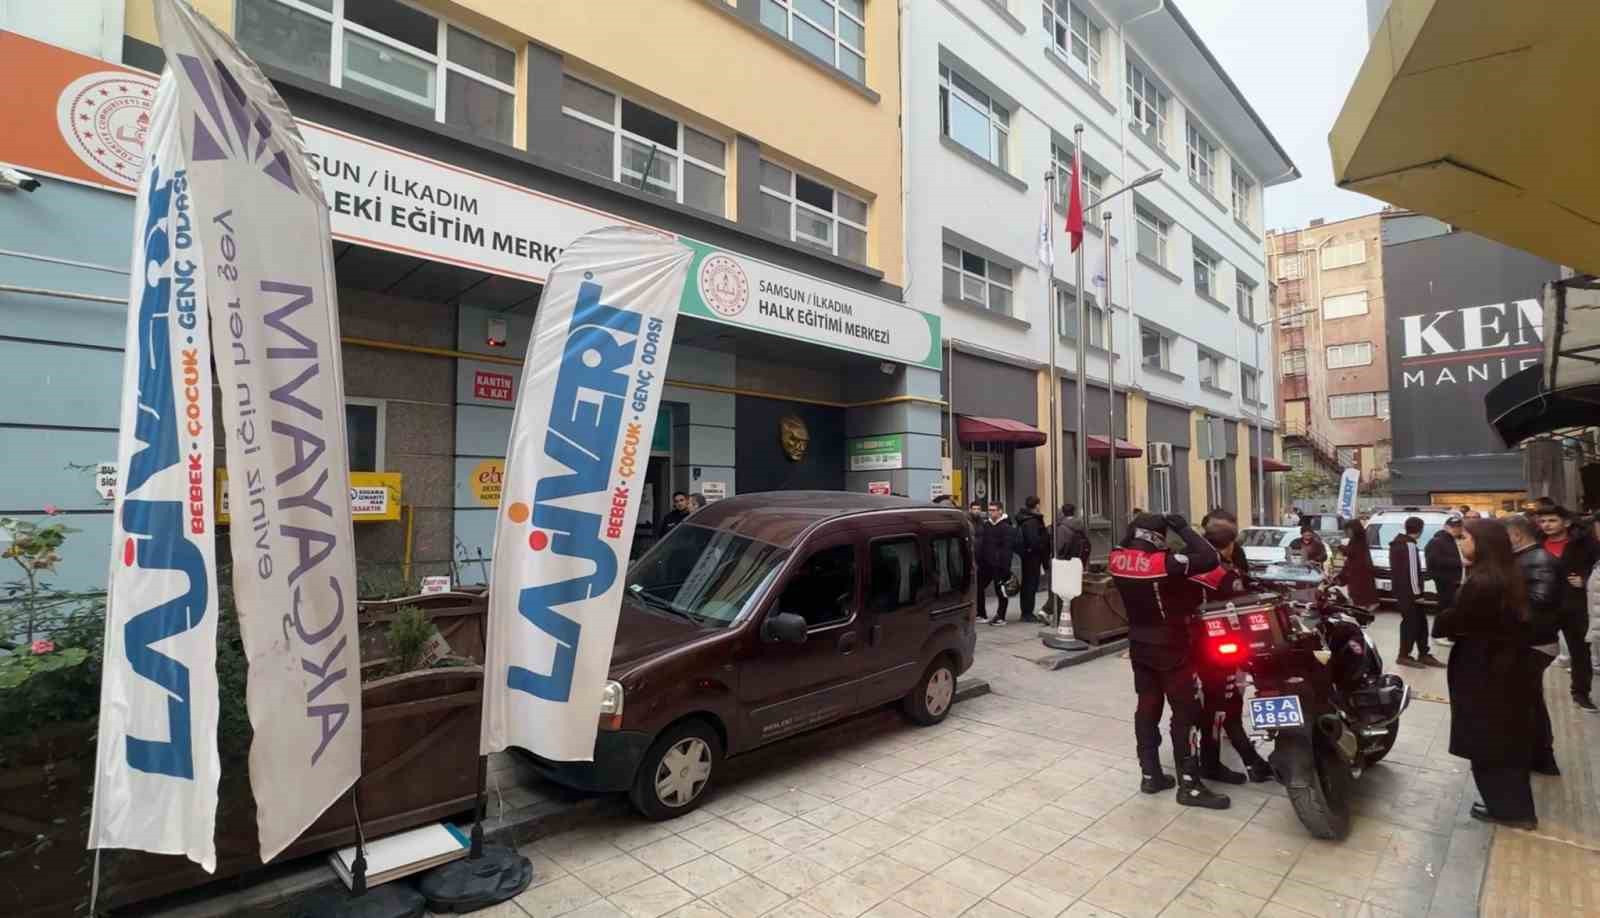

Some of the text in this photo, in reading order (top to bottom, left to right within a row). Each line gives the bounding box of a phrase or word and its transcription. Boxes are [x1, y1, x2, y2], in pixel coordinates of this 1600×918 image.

[383, 170, 478, 215] İLKADIM
[329, 190, 564, 264] EKİ EĞİTİM MERK
[759, 280, 805, 304] SAMSUN
[812, 292, 852, 315] İLKADIM
[759, 300, 890, 345] HALK EĞİTİMİ MERKEZİ
[174, 169, 204, 534] BEBEK ÇOCUK GENÇ ODASI
[490, 388, 508, 399] KAT
[606, 317, 664, 539] BEBEK ÇOCUK GENÇ ODASI
[1207, 620, 1222, 629] 112
[1249, 614, 1265, 623] 112
[1253, 699, 1295, 712] 55 A
[1256, 711, 1300, 723] 4850
